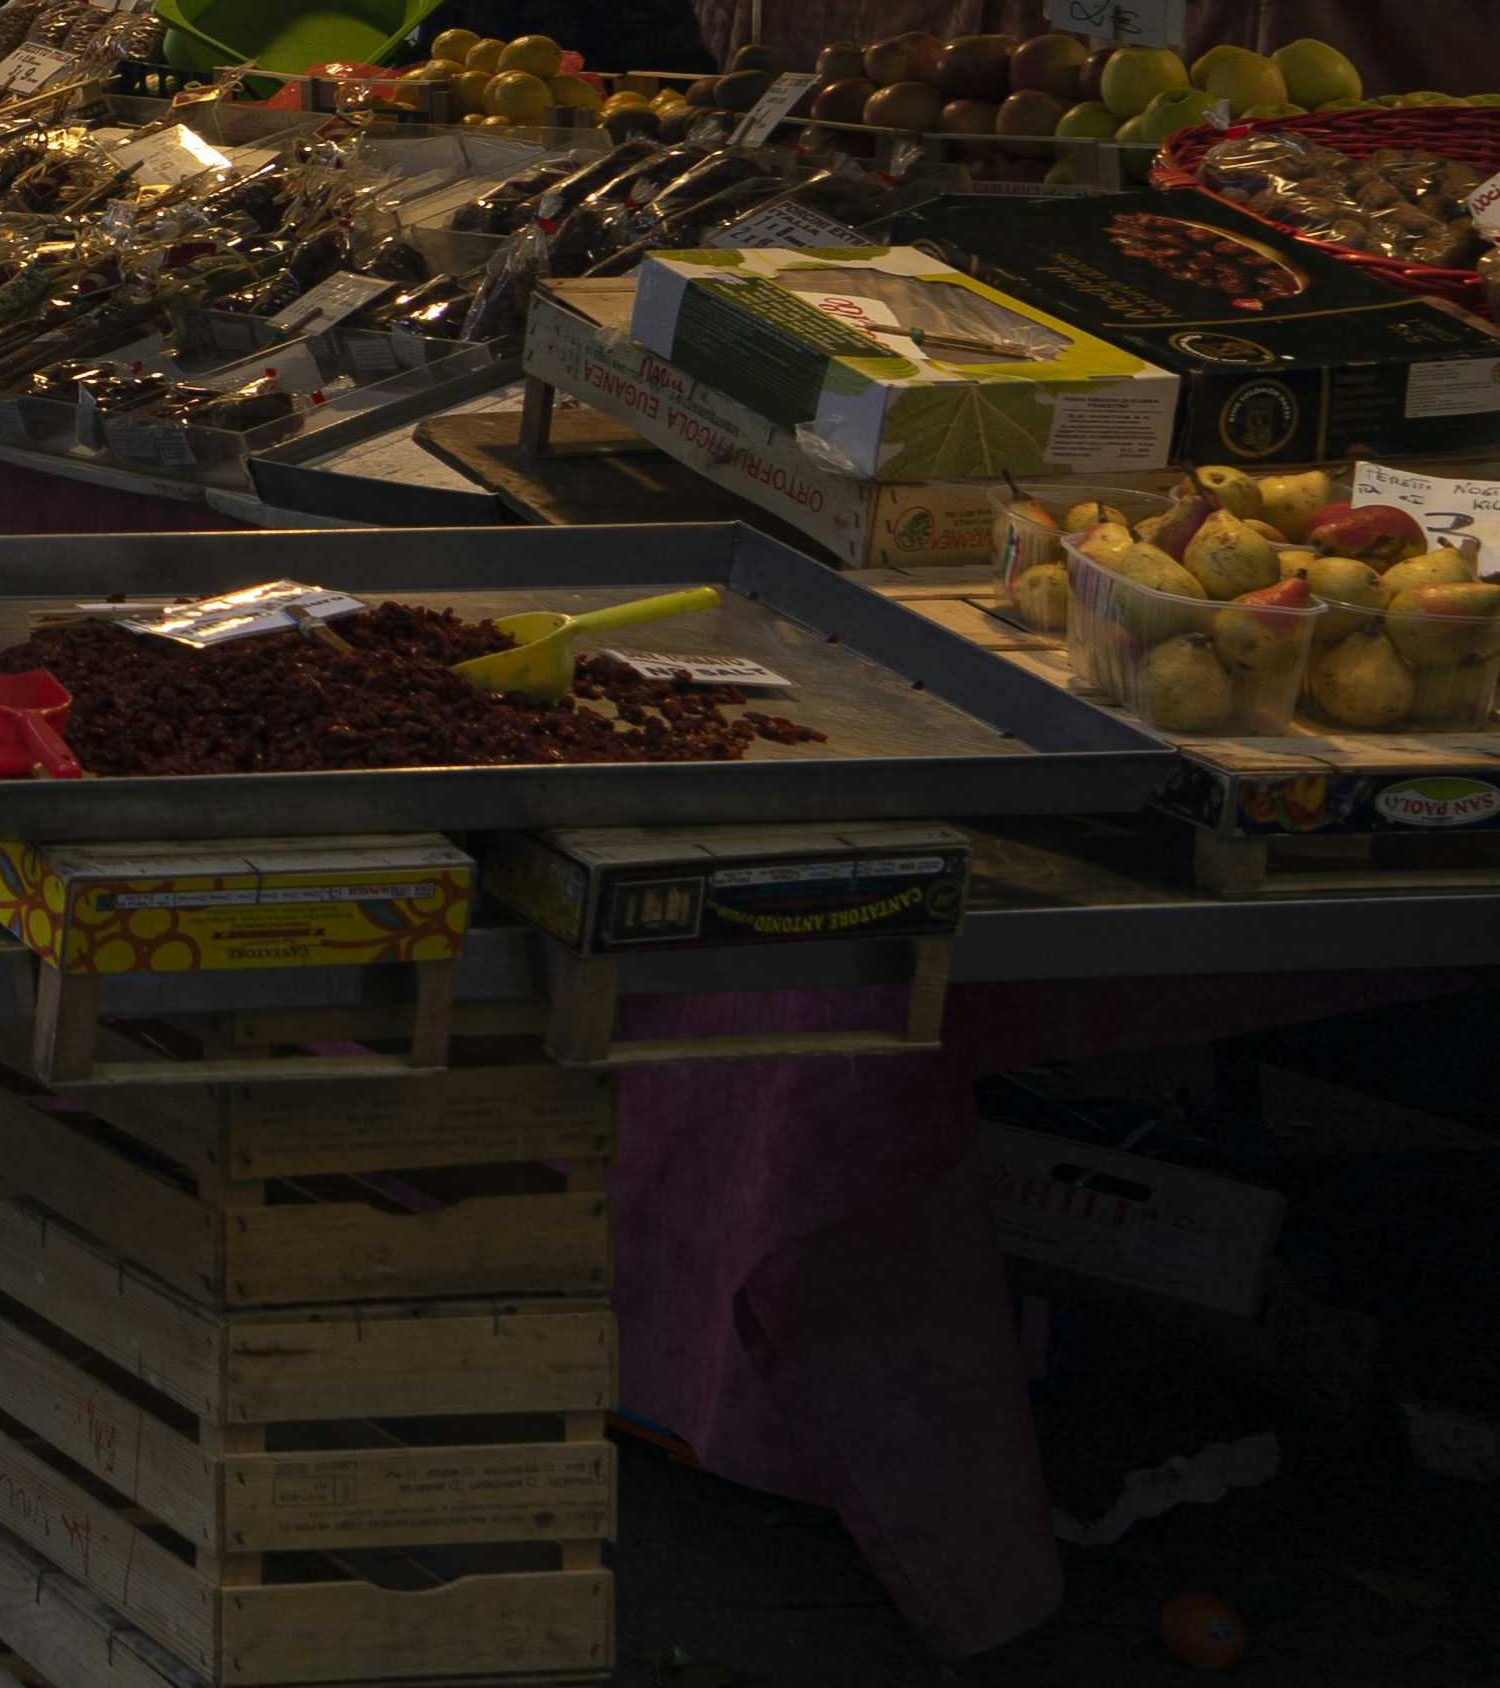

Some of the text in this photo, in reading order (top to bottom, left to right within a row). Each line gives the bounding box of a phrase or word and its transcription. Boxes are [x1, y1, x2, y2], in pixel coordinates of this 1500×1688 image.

[730, 227, 747, 239] 2
[754, 215, 772, 226] 1
[767, 207, 819, 236] ITALIA
[778, 201, 873, 247] PORCINI EXTR
[1036, 266, 1157, 318] Medjoul
[583, 358, 660, 420] EUGANEA
[694, 667, 768, 677] SALT
[1454, 793, 1495, 814] SAN
[753, 886, 924, 934] CANTATORE ANTONIO
[226, 946, 312, 961] CANTATORE
